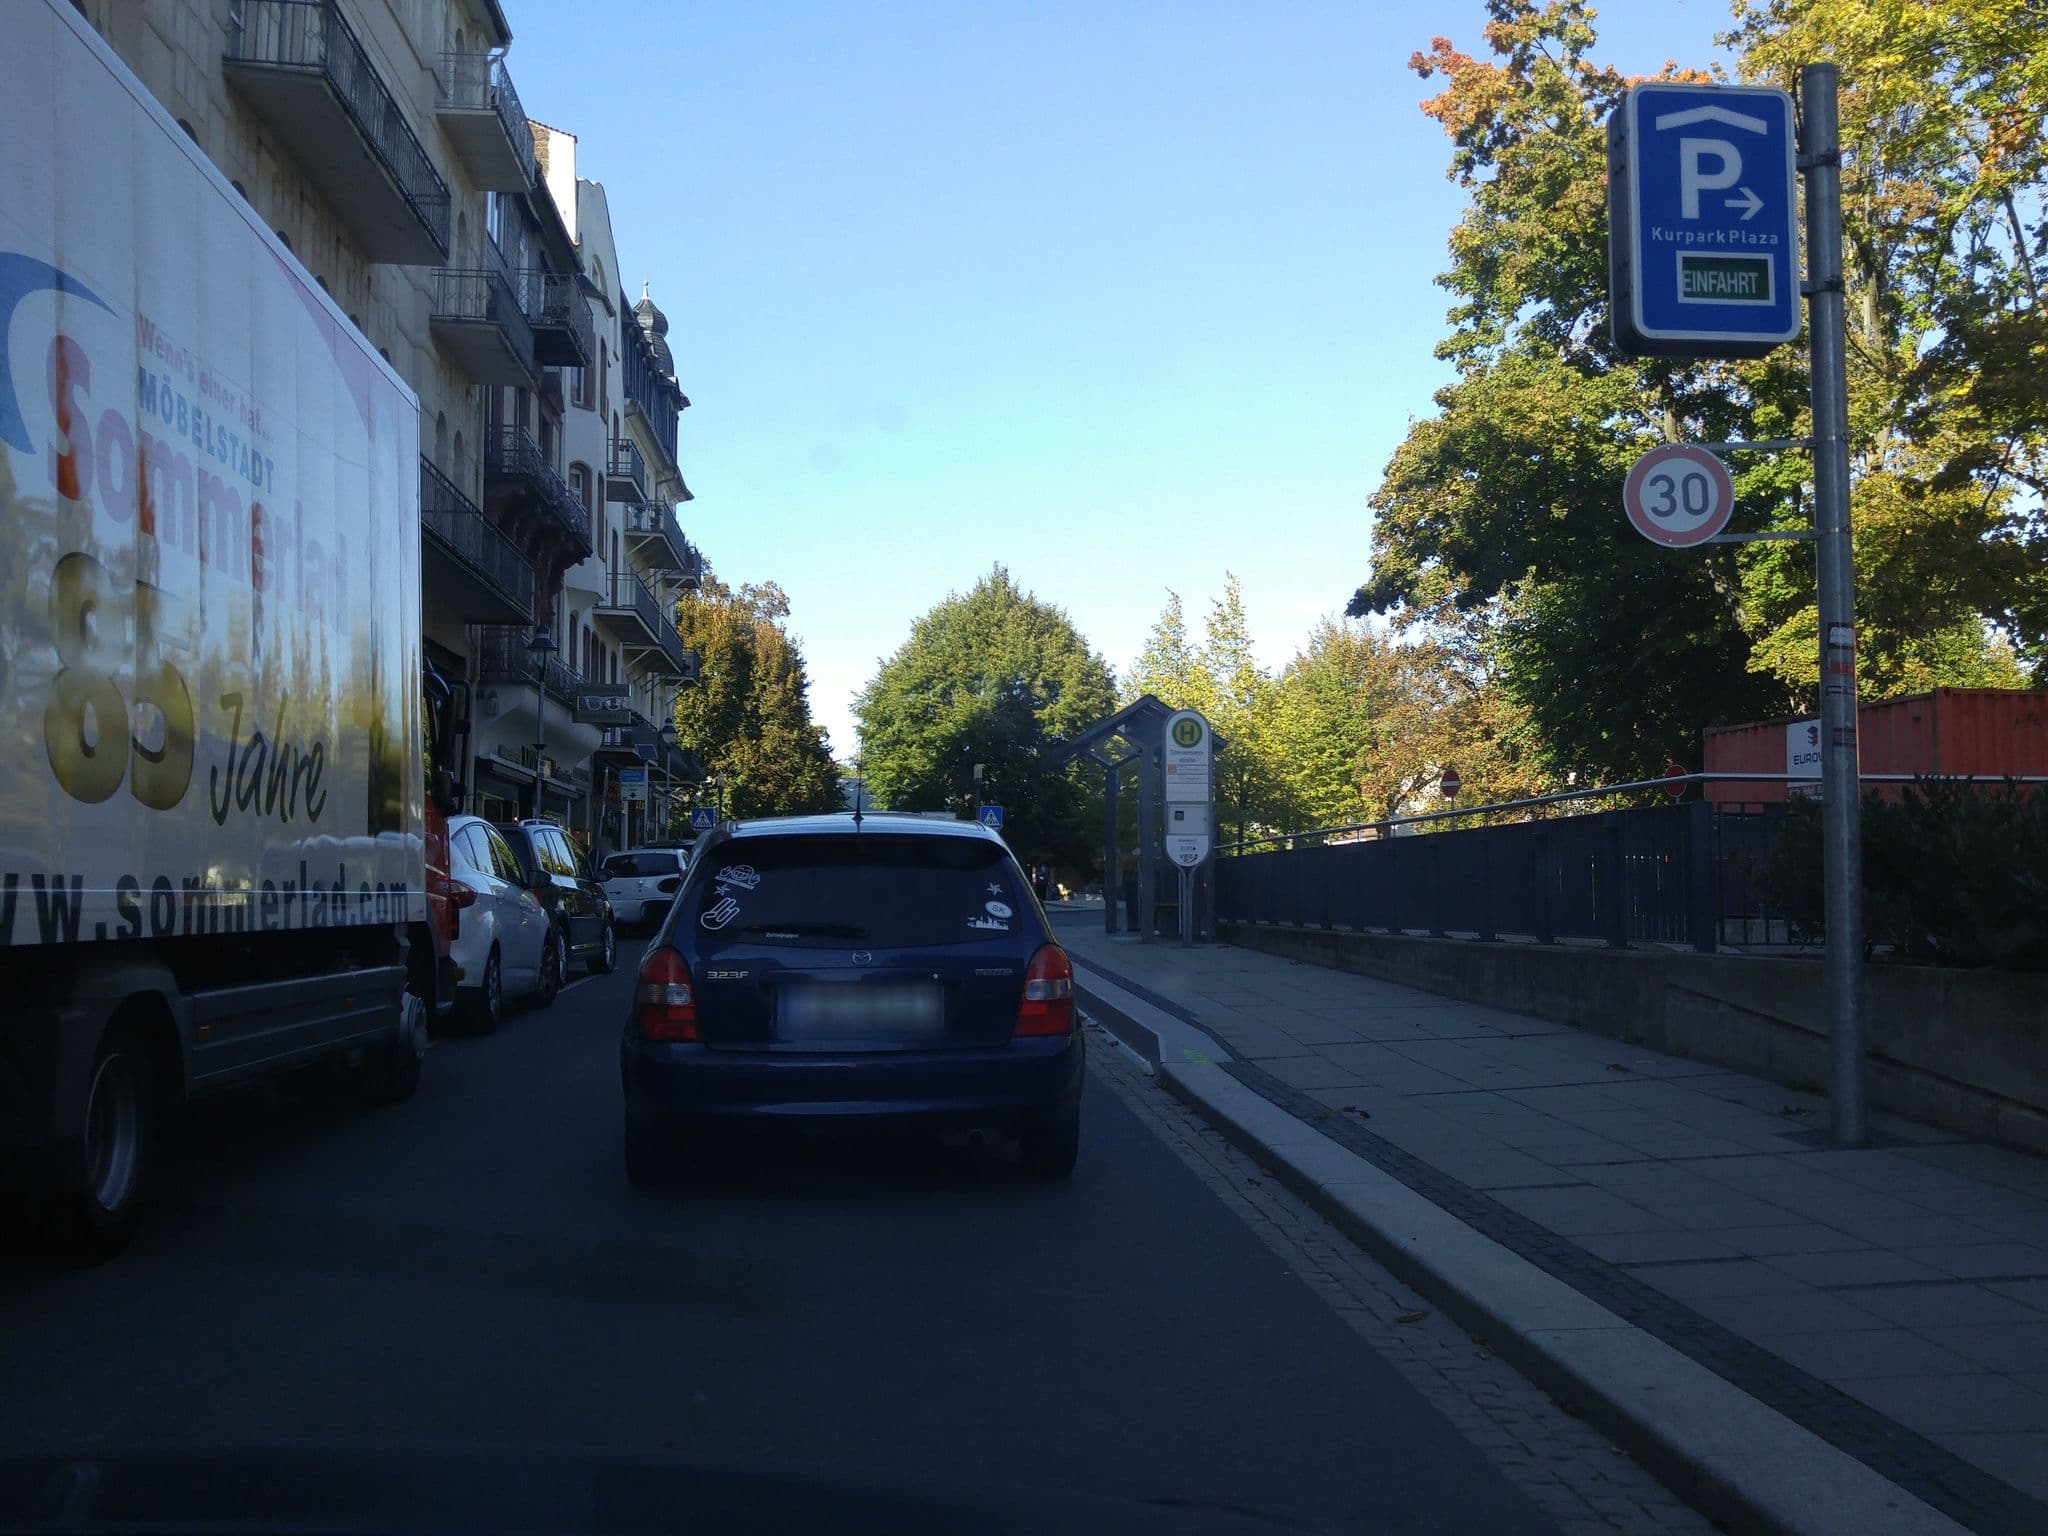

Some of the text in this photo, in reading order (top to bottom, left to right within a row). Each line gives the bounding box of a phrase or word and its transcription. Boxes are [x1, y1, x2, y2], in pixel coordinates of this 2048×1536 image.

[1680, 137, 1743, 220] P
[1682, 269, 1759, 294] EINFAHRT
[200, 368, 236, 416] einer
[138, 365, 275, 494] MÖBELSTADT
[46, 334, 348, 637] Sommerlad
[1648, 472, 1710, 518] 30
[209, 688, 327, 827] Jahre
[991, 904, 1006, 915] SK
[706, 971, 750, 980] 323F
